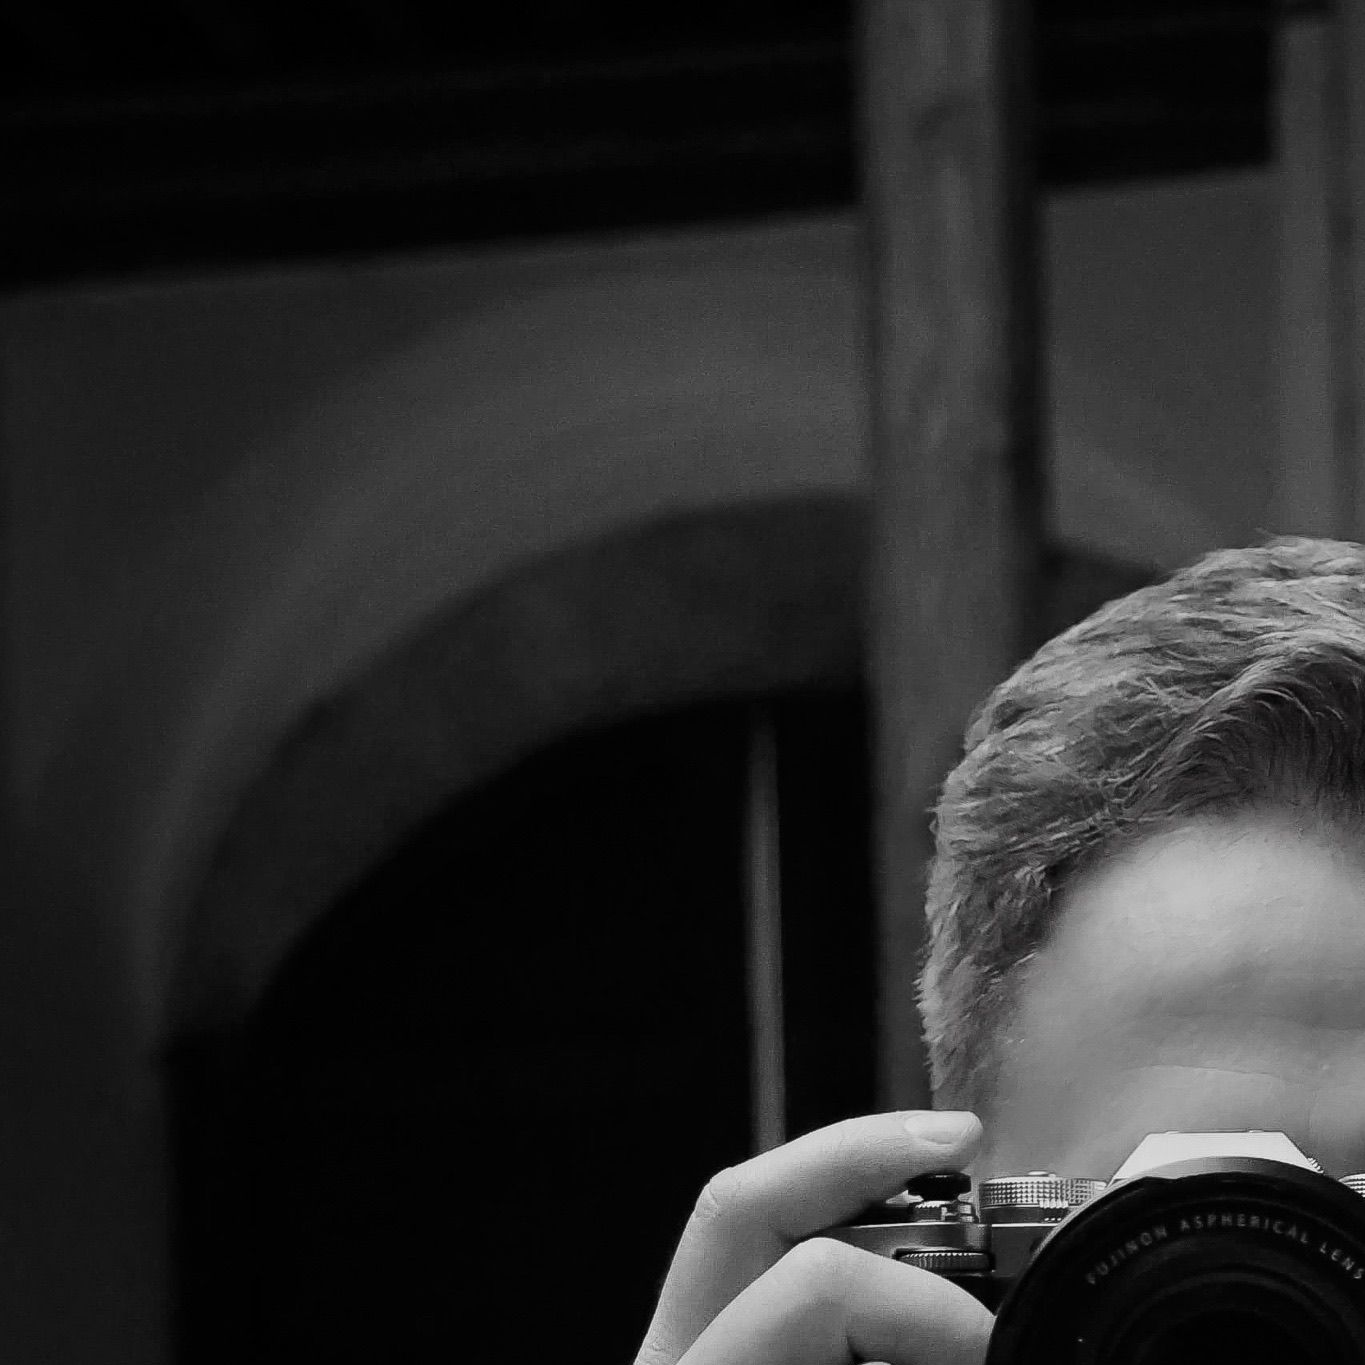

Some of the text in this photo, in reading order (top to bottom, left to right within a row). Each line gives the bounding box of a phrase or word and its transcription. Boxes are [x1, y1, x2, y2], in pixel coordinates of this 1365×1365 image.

[1085, 1212, 1365, 1286] FUJINON ASPHERICAL LENS
